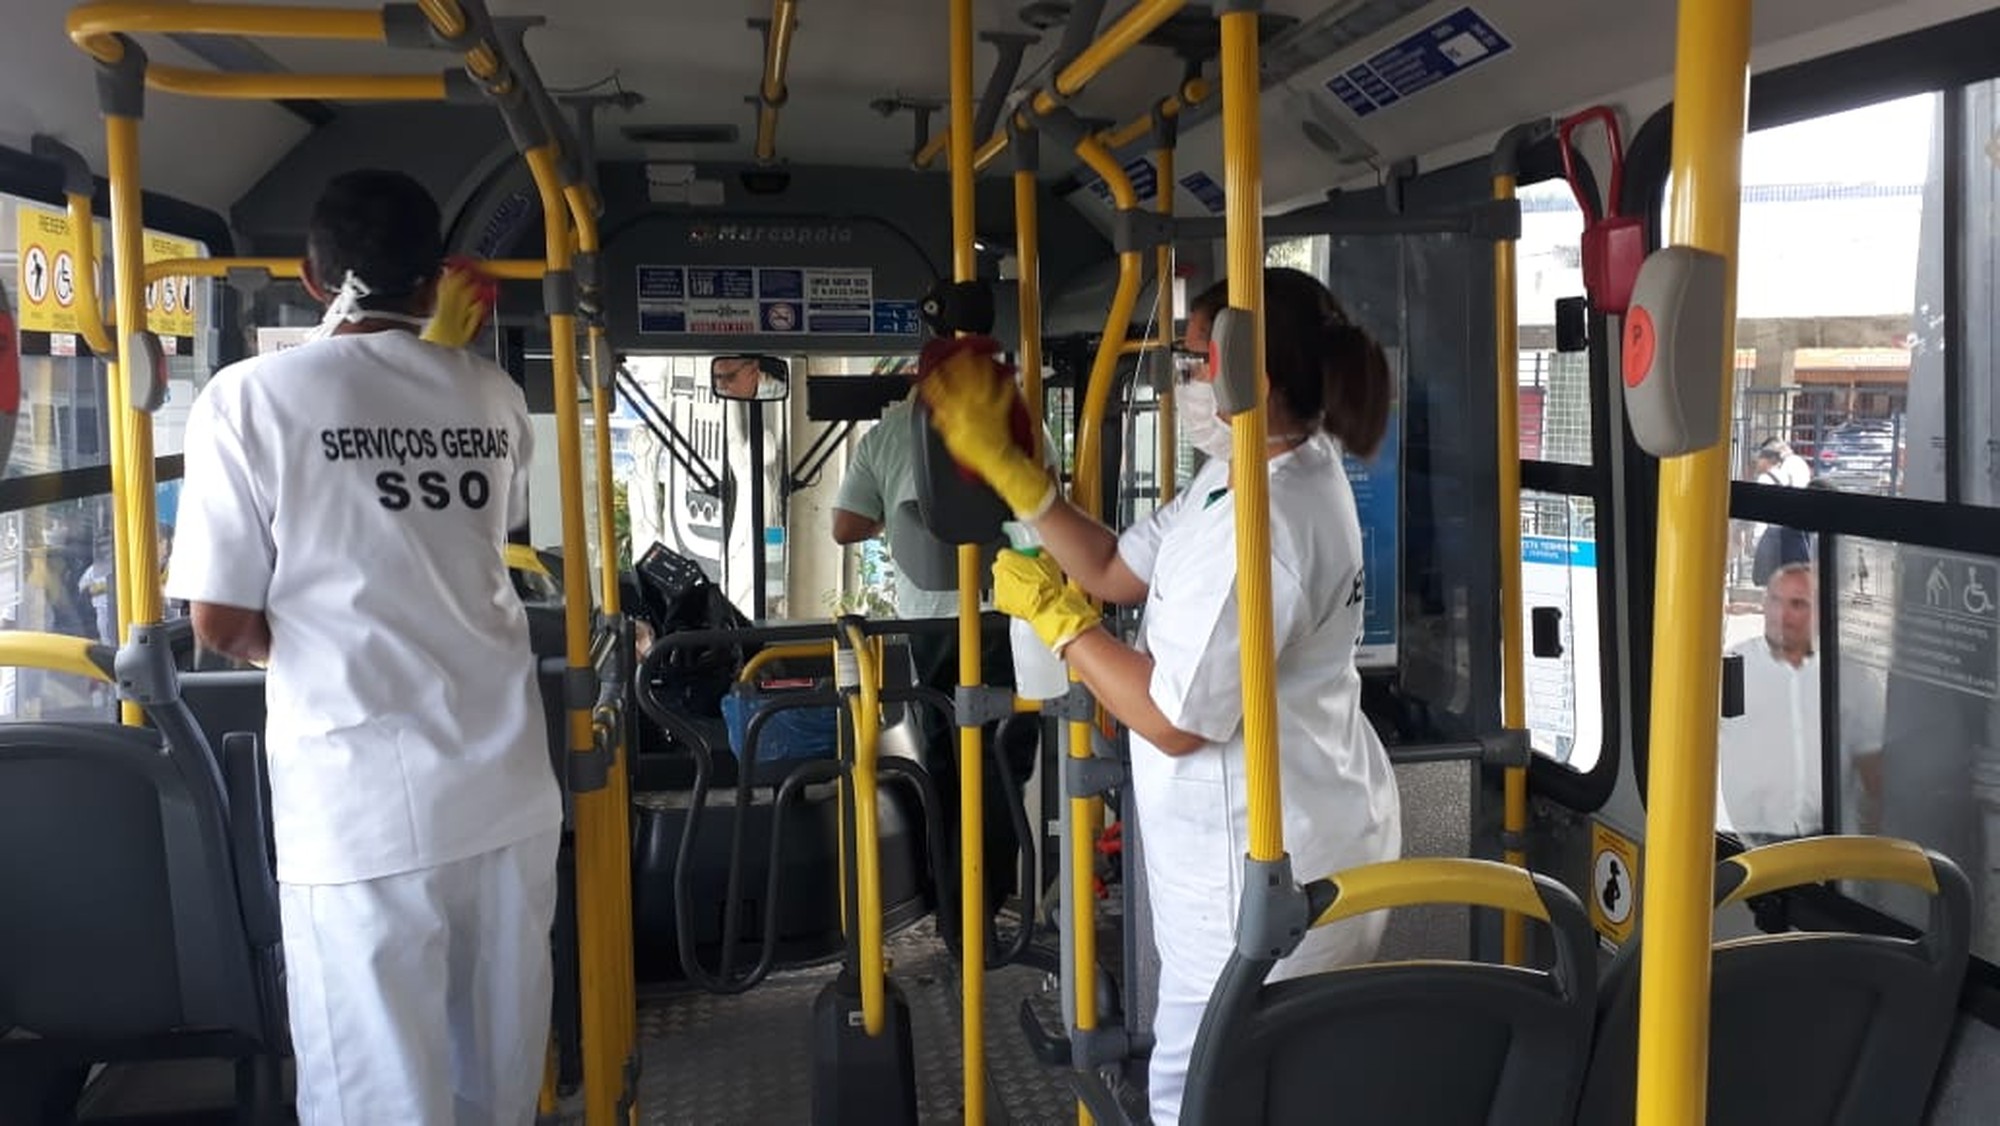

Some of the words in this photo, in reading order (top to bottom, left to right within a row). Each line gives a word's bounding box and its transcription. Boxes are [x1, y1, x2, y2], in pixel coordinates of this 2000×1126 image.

[1632, 324, 1643, 347] P
[321, 428, 438, 465] SERVIÇOS
[441, 427, 509, 460] GERAIS
[375, 470, 490, 511] SSO
